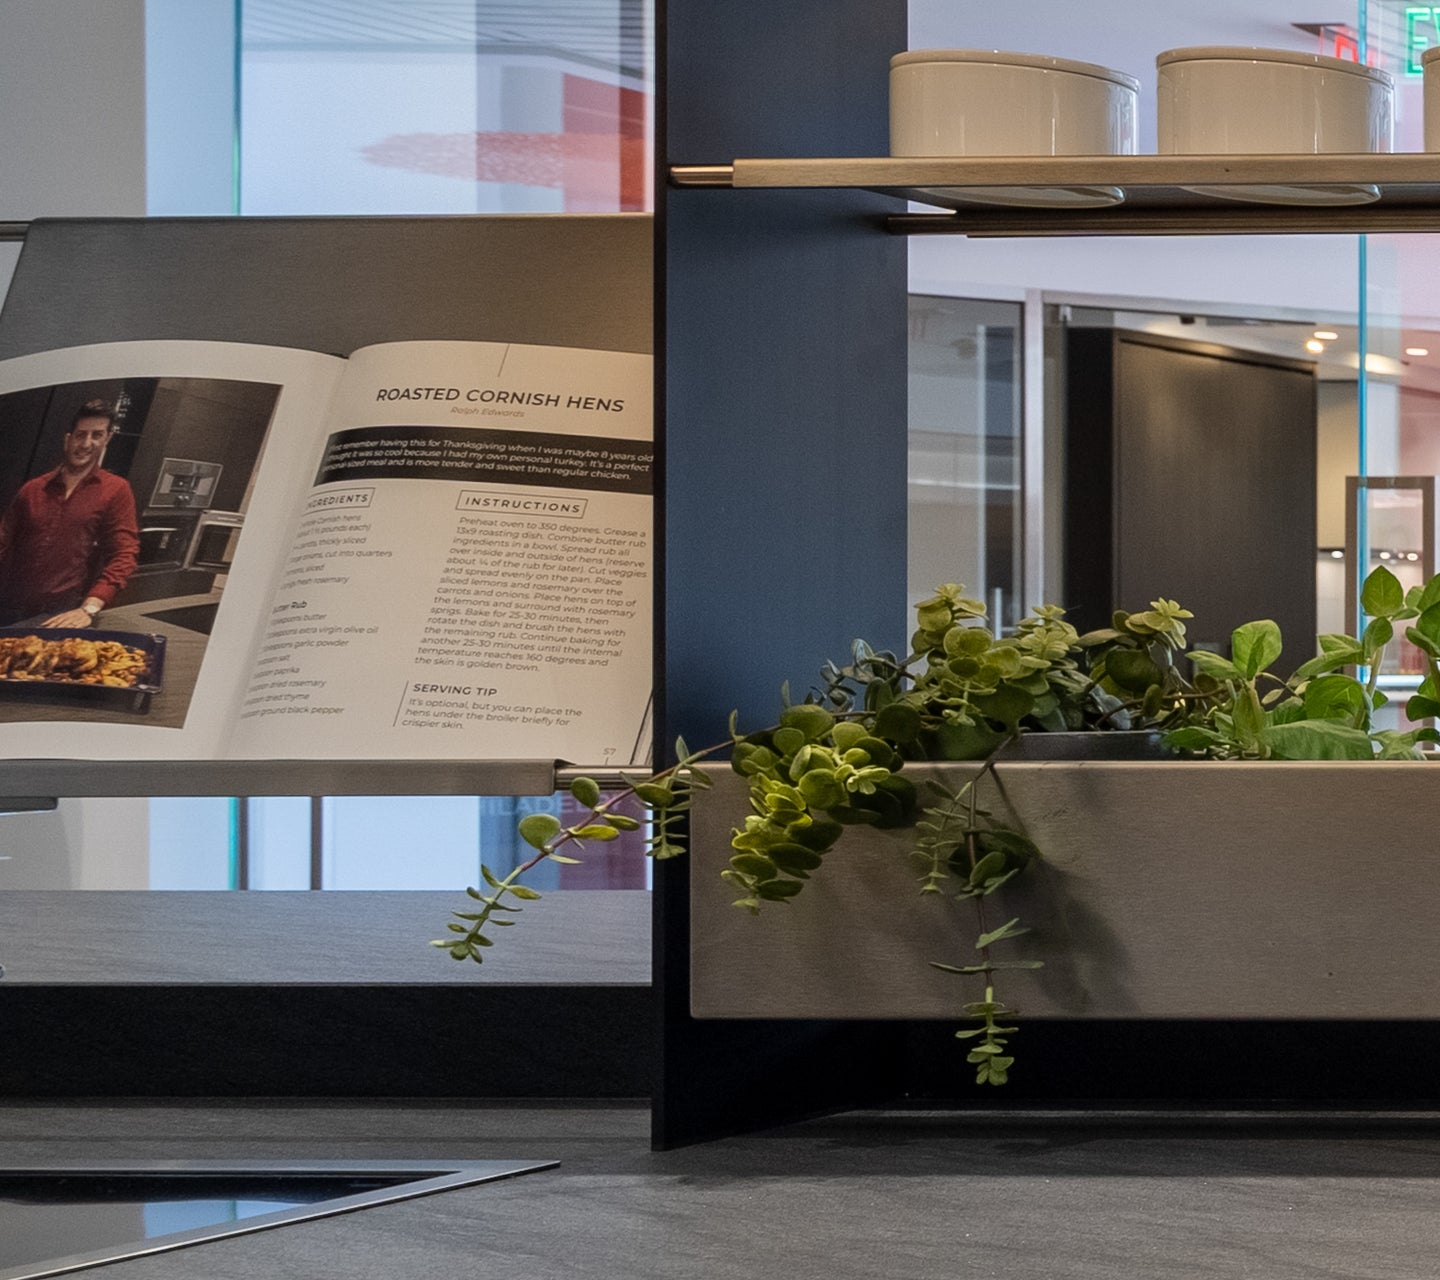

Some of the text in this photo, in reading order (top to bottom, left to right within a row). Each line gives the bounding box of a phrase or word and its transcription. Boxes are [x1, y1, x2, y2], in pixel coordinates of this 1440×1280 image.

[376, 387, 625, 413] ROASTED CORNISH HENS
[450, 406, 526, 418] Ralph Edwards
[380, 439, 408, 449] having
[410, 439, 426, 447] this
[428, 439, 441, 447] for
[443, 440, 506, 453] Thanksgiving
[507, 444, 536, 453] when
[564, 450, 599, 459] maybe
[609, 453, 636, 462] years
[404, 449, 442, 457] because
[448, 450, 467, 458] had
[509, 455, 553, 465] personal
[554, 457, 587, 469] turkey.
[589, 460, 604, 469] It's
[613, 463, 650, 472] perfect
[441, 460, 474, 469] tender
[496, 464, 526, 472] sweet
[527, 465, 551, 474] than
[552, 468, 589, 478] regular
[590, 470, 632, 479] chicken.
[465, 496, 580, 513] INSTRUCTIONS
[412, 683, 498, 697] SERVING TIP
[409, 699, 424, 707] It's
[425, 700, 471, 712] optional,
[471, 703, 491, 711] but
[492, 705, 512, 714] you
[534, 707, 563, 716] place
[564, 709, 583, 717] the
[401, 720, 464, 730] crispier skin.
[404, 709, 570, 727] hens under the broiler briefly for
